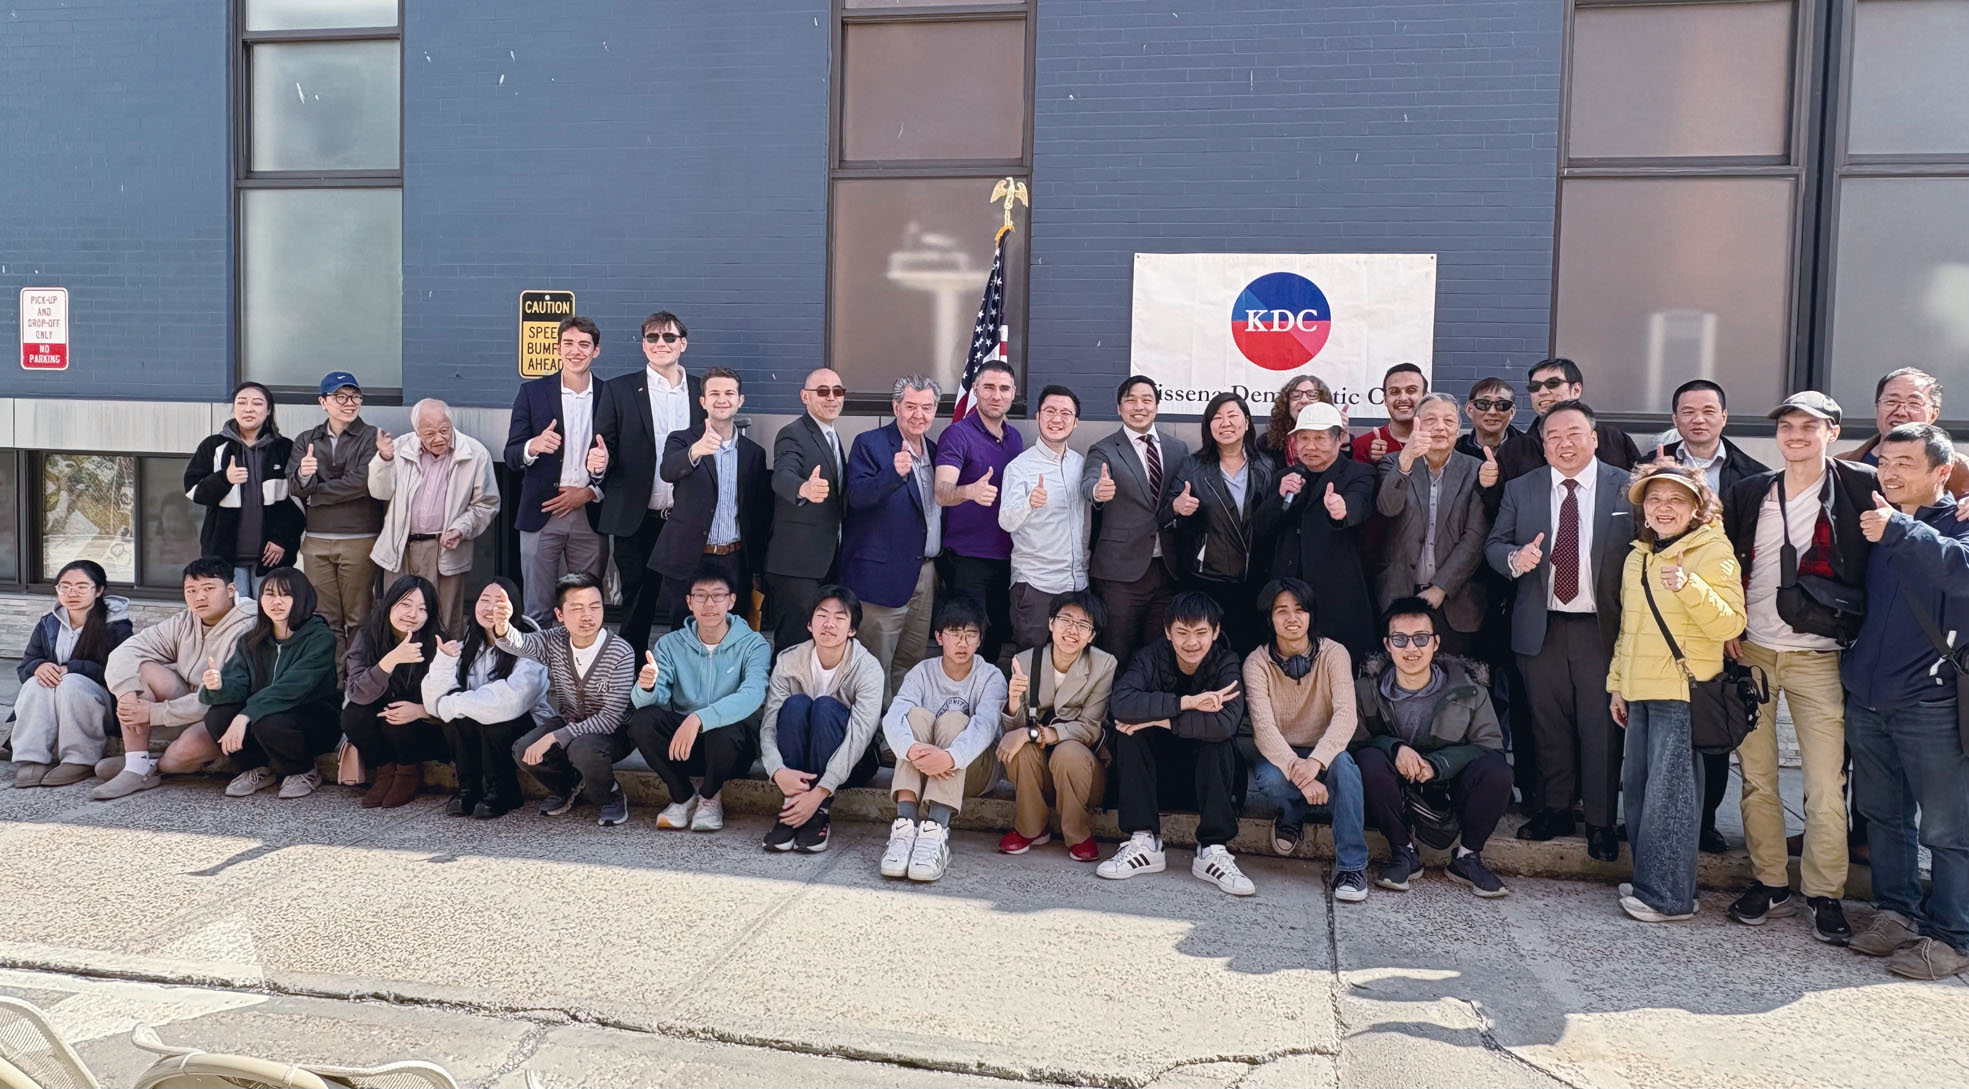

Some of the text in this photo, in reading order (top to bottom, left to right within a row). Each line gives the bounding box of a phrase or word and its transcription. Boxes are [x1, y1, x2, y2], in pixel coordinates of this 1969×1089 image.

[30, 296, 58, 304] PICK-UP
[37, 307, 52, 316] AND
[525, 301, 570, 314] CAUTION
[27, 319, 61, 328] DROP-OFF
[1244, 308, 1318, 332] KDC
[35, 330, 53, 339] ONLY
[528, 326, 557, 339] SPEE
[39, 344, 50, 353] NO
[527, 342, 559, 355] BUMP
[29, 354, 61, 364] PARKING
[527, 358, 564, 371] AHEAD
[1157, 383, 1221, 401] issen
[1231, 384, 1360, 405] Demtic
